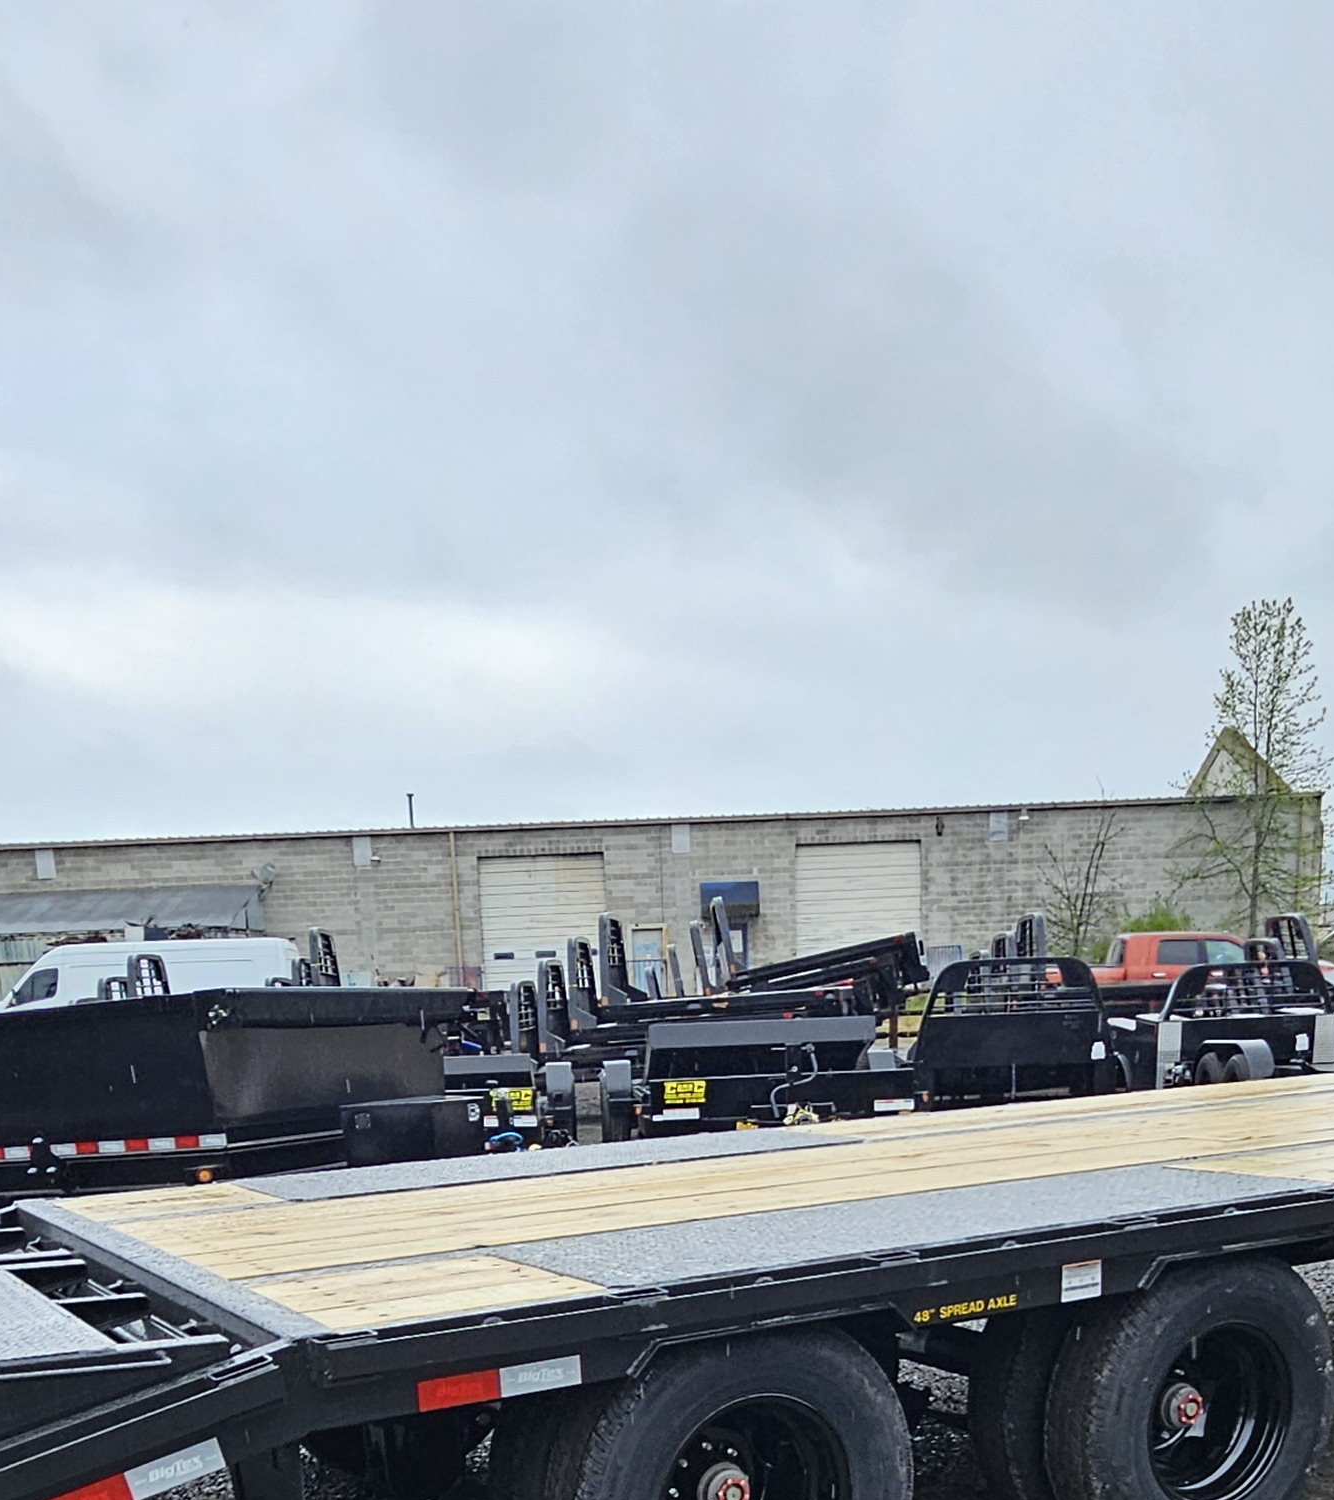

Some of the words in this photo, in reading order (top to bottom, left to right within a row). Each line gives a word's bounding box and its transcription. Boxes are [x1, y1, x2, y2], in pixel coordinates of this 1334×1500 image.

[913, 1308, 936, 1323] 48"
[939, 1300, 985, 1319] SPREAD
[987, 1294, 1017, 1311] AXLE
